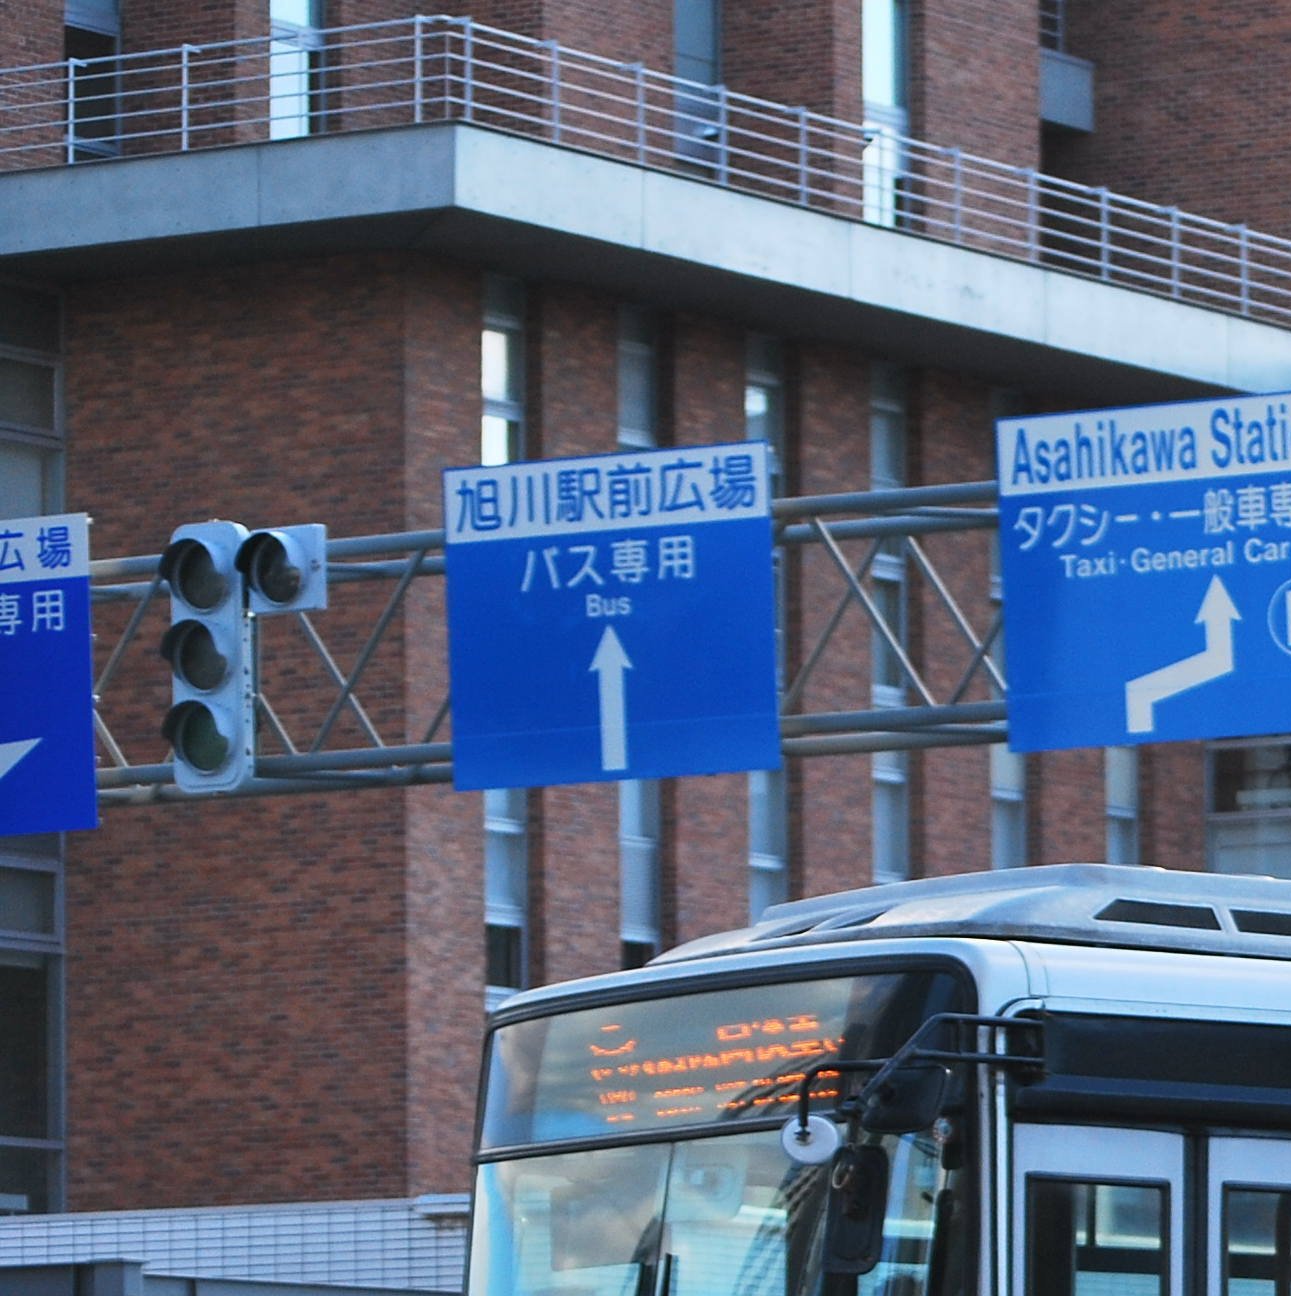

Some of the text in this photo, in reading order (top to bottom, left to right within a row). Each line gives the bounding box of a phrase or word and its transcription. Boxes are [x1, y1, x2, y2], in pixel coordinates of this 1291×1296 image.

[1011, 418, 1198, 486] Asahikawa
[455, 453, 757, 534] 旭川駅前広場
[520, 534, 696, 593] バス専用
[1243, 536, 1291, 563] Car
[586, 594, 633, 618] Bus
